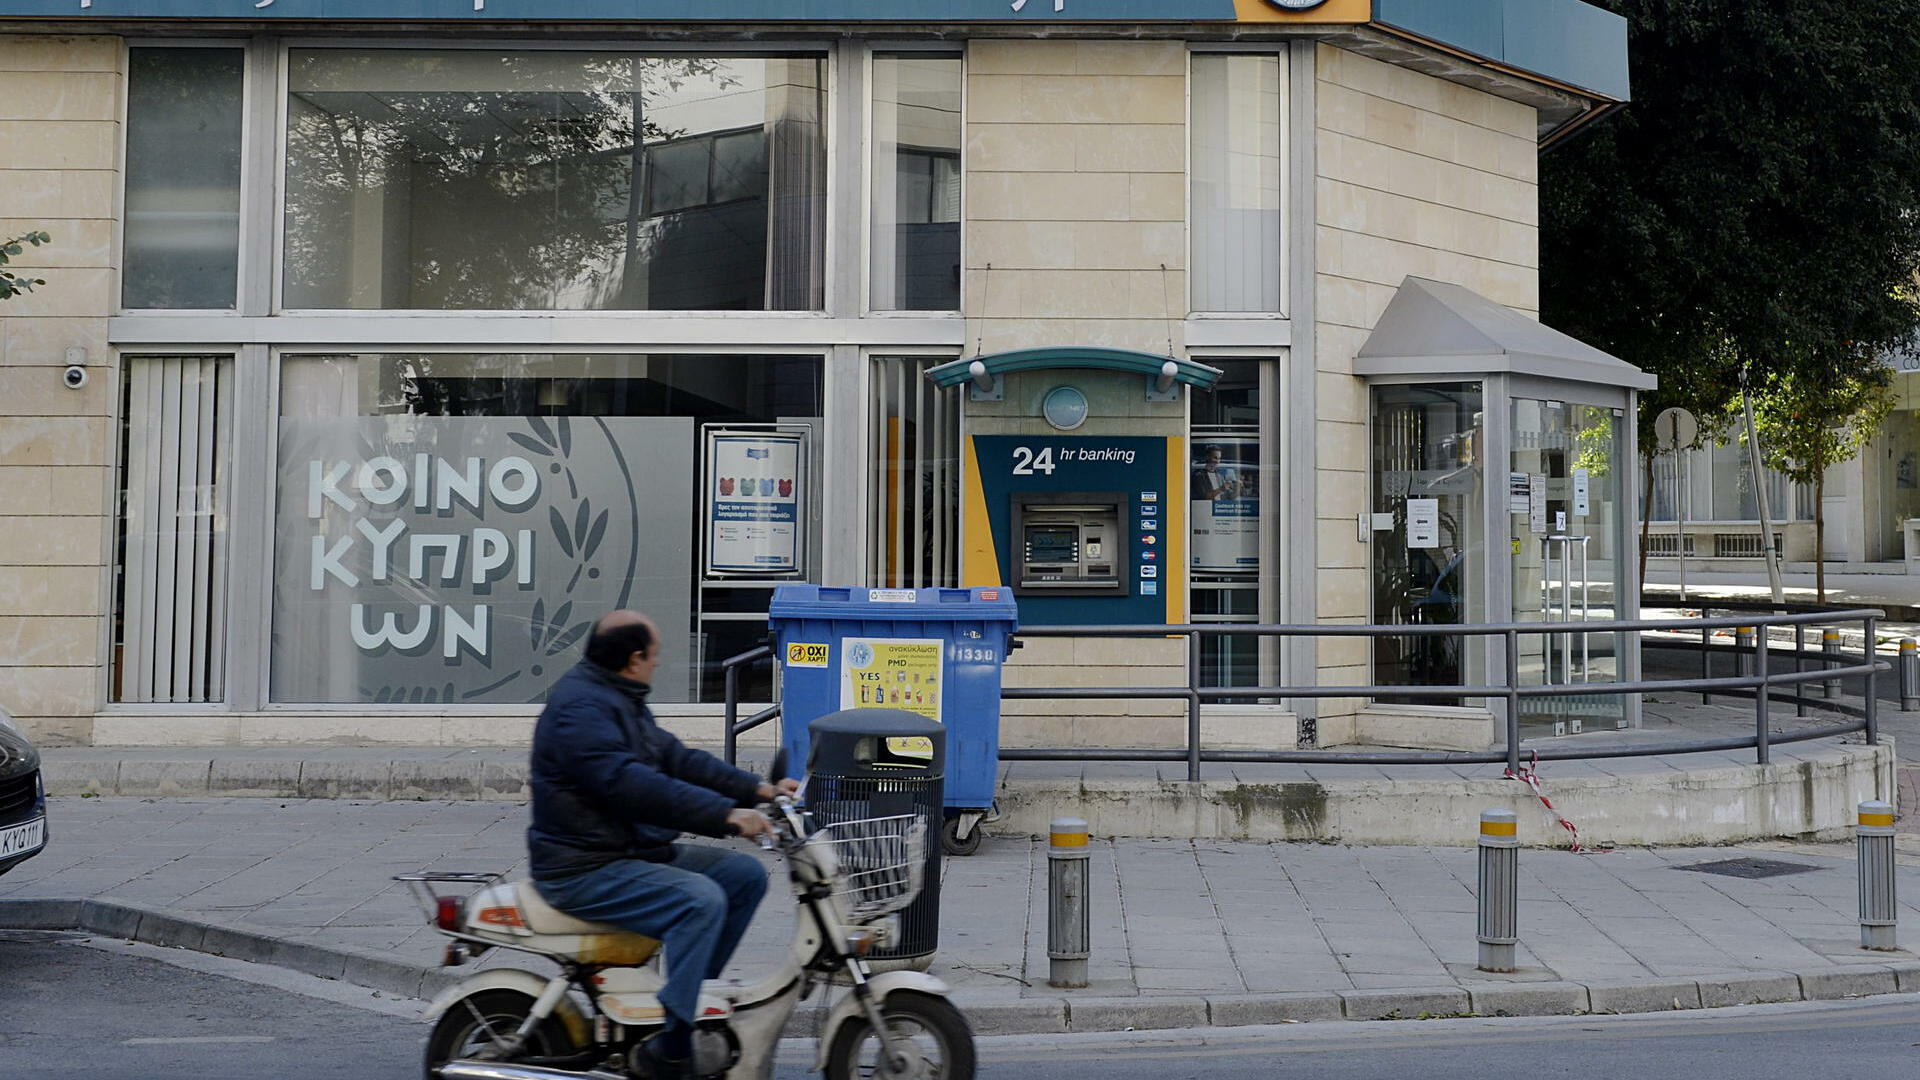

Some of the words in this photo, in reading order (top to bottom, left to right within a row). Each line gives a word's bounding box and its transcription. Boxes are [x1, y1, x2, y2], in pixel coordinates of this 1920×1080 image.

[1013, 447, 1056, 475] 24
[1060, 448, 1076, 461] hr
[1078, 448, 1136, 464] banking
[308, 453, 538, 518] ΚΟΙΝΟ
[311, 517, 532, 590] ΚΥΠΡΙ
[807, 646, 826, 656] ΟΧΙ
[888, 659, 907, 667] PMD
[859, 672, 881, 681] YES
